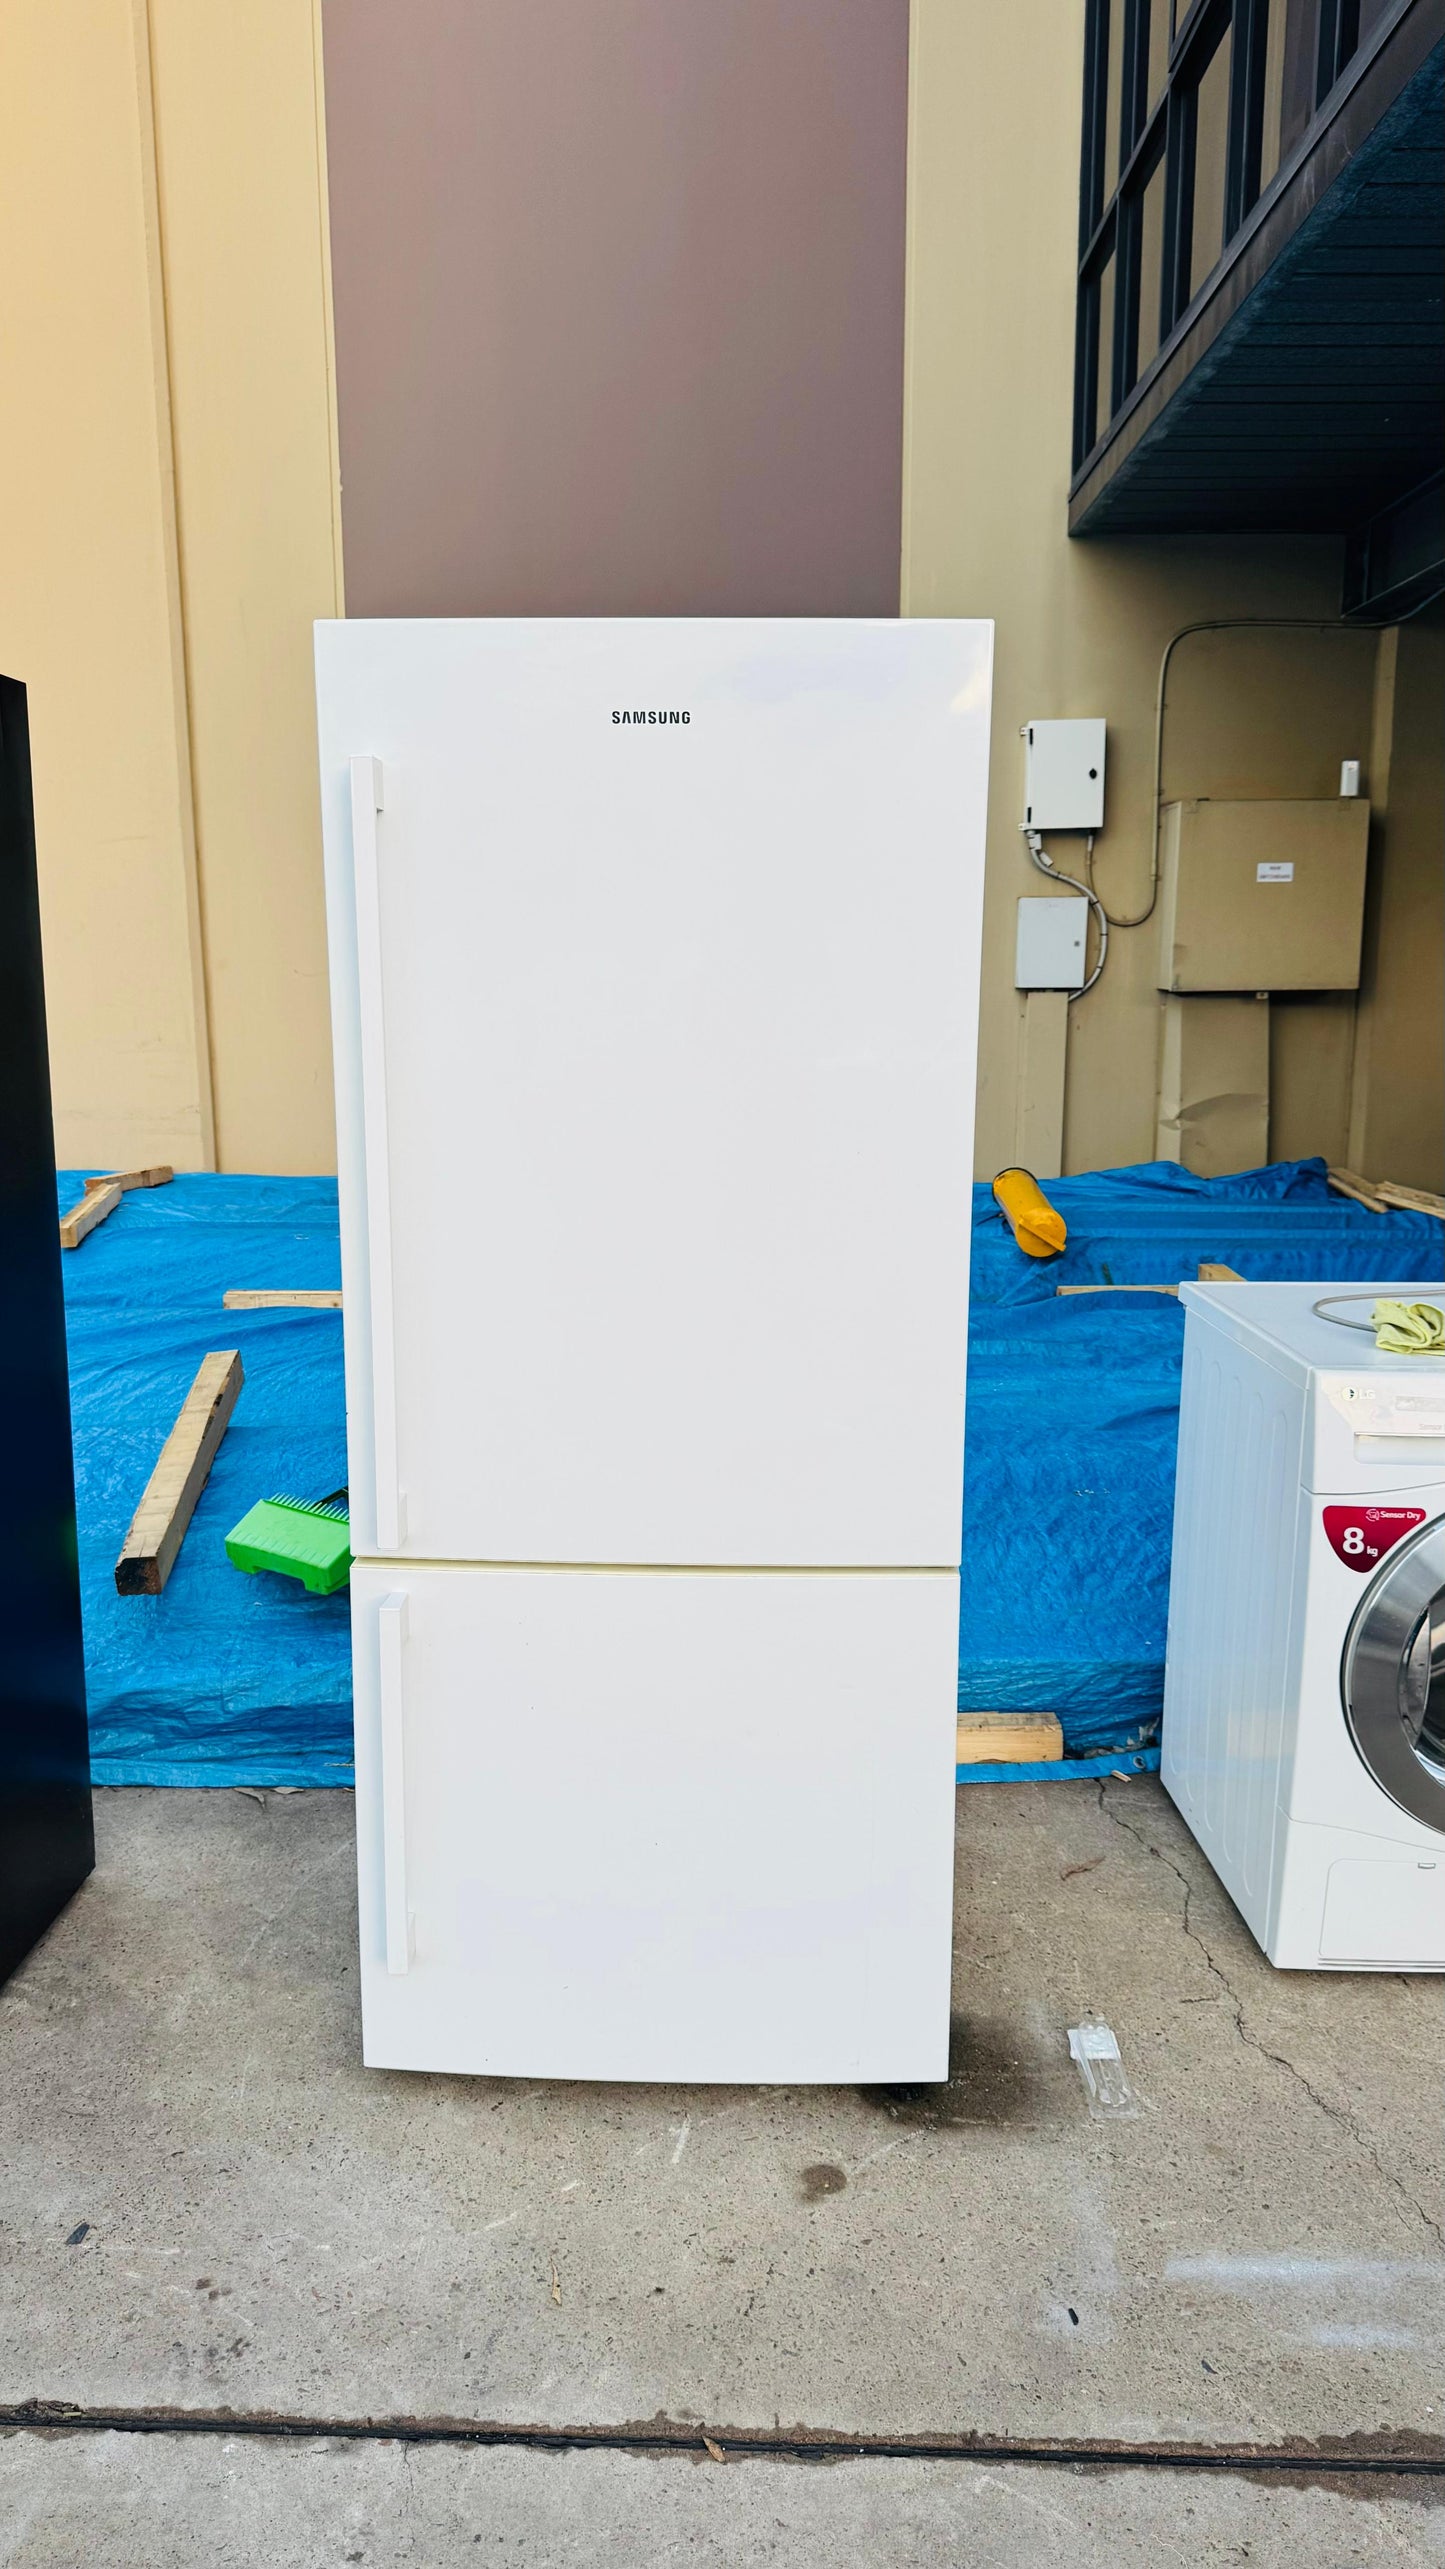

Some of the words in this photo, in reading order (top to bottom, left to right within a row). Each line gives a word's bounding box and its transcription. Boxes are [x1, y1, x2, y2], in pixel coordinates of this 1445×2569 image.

[611, 710, 691, 724] SAMSUNG
[1380, 1510, 1406, 1519] Sensor
[1406, 1511, 1421, 1521] Dry
[1342, 1527, 1365, 1555] 8
[1366, 1545, 1379, 1557] kg
